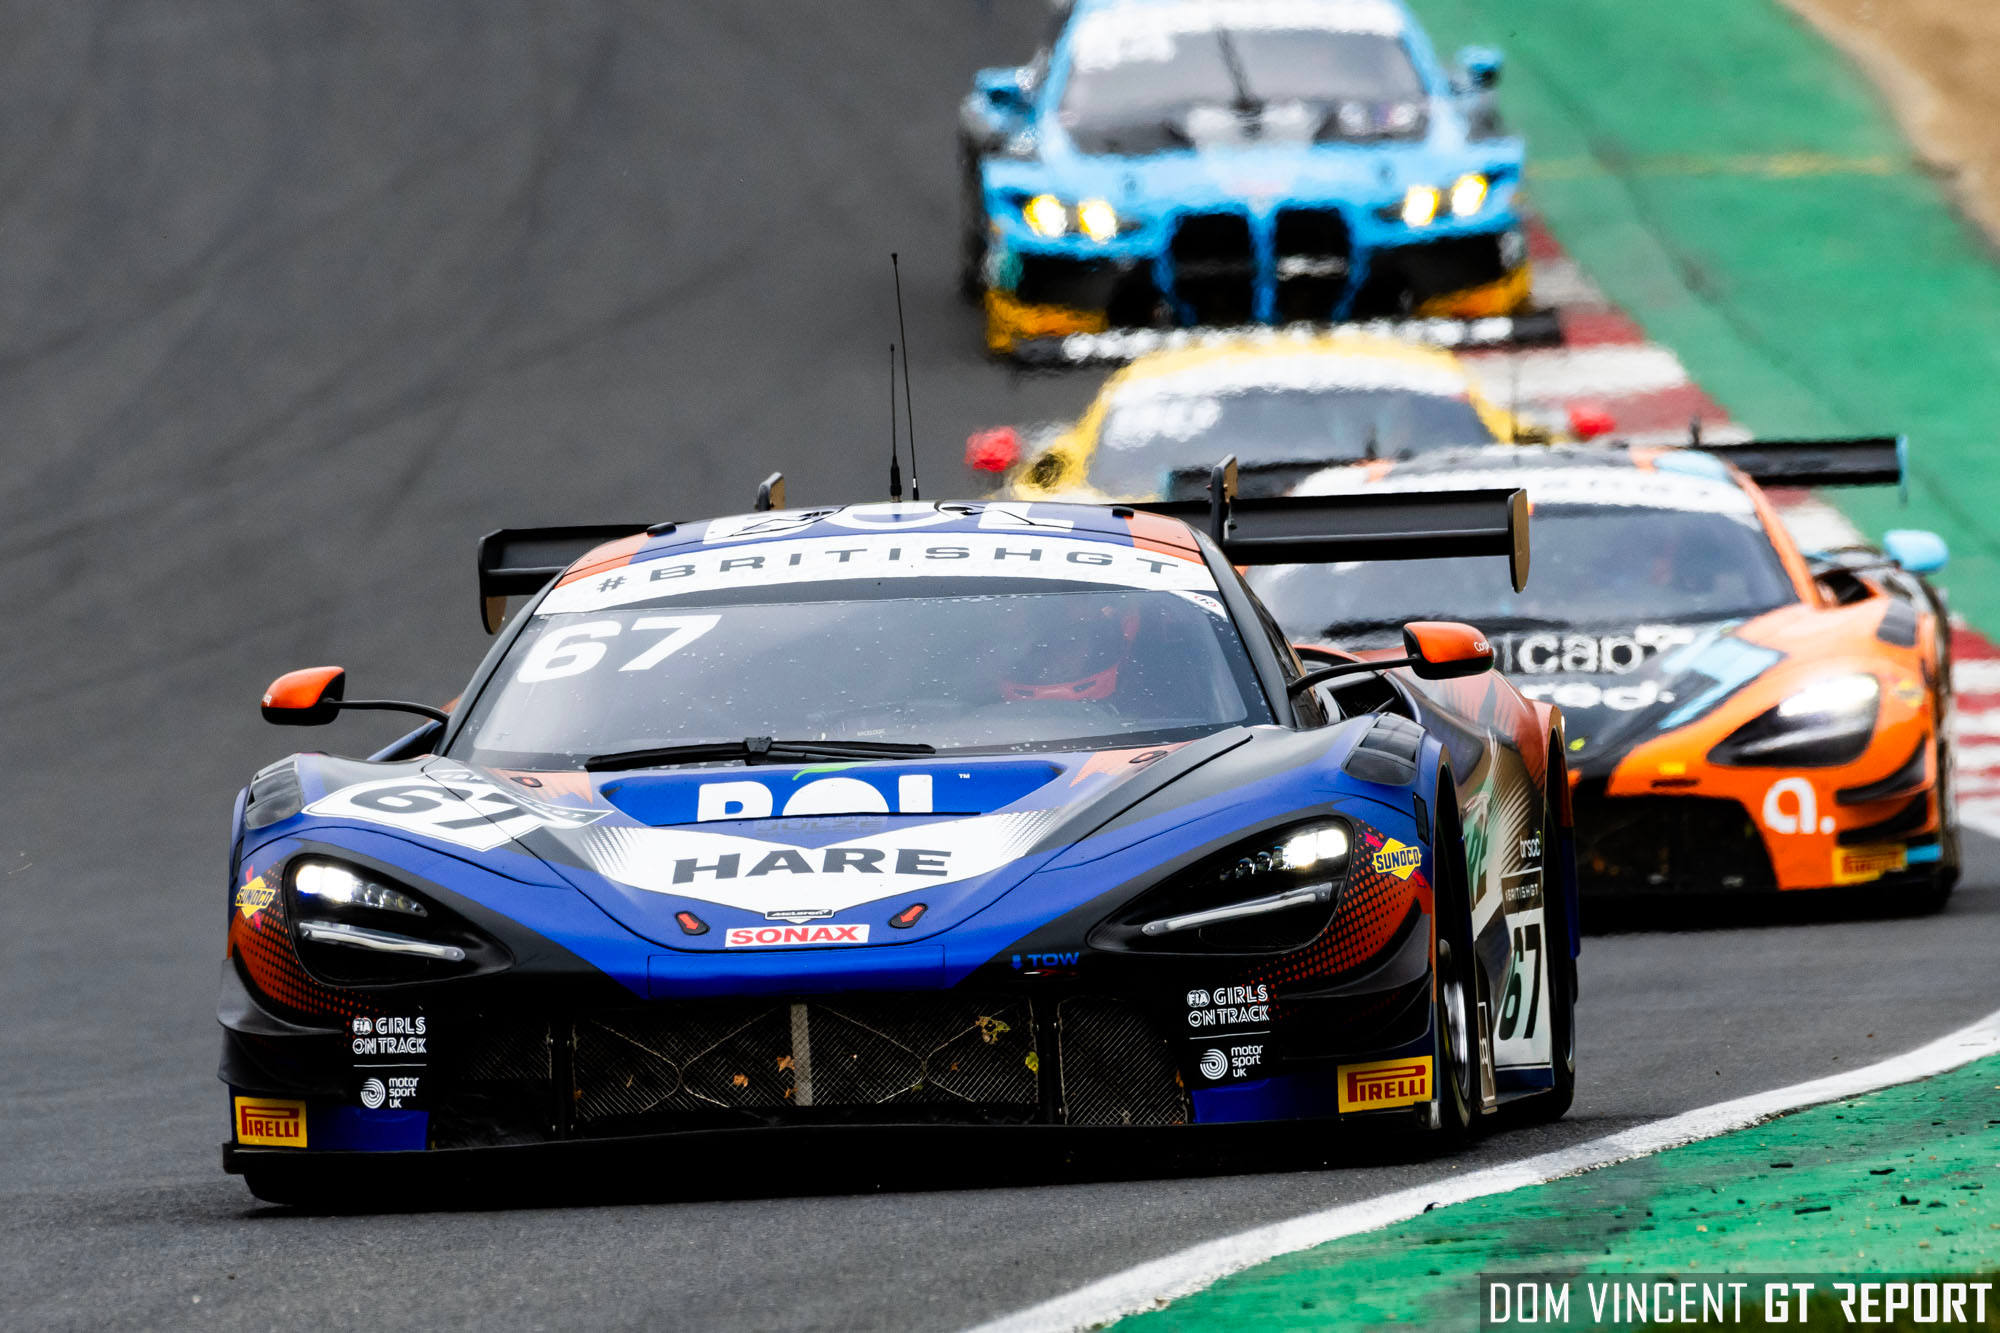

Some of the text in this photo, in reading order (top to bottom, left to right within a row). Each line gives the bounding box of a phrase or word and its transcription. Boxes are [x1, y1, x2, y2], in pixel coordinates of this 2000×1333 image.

[597, 547, 1179, 592] #BRITISHGT
[516, 614, 722, 683] 67
[350, 785, 528, 829] 67
[672, 847, 953, 885] HARE
[1375, 845, 1421, 872] SUNOCO
[236, 888, 273, 906] SUNOCO
[730, 926, 859, 945] SONAX
[1027, 951, 1080, 967] TOW
[1498, 923, 1542, 1041] 67
[1213, 984, 1268, 1006] GIRLS
[375, 1016, 426, 1034] GIRLS
[1188, 1005, 1270, 1028] ON TRACK
[352, 1036, 427, 1054] ON TRACK
[1230, 1045, 1263, 1056] motor
[1231, 1054, 1261, 1067] sport
[388, 1077, 419, 1088] motor
[1232, 1068, 1247, 1078] UK
[1346, 1064, 1427, 1103] PIRELLI
[388, 1087, 416, 1100] sport
[388, 1099, 402, 1109] UK
[240, 1105, 300, 1139] PIRELLI
